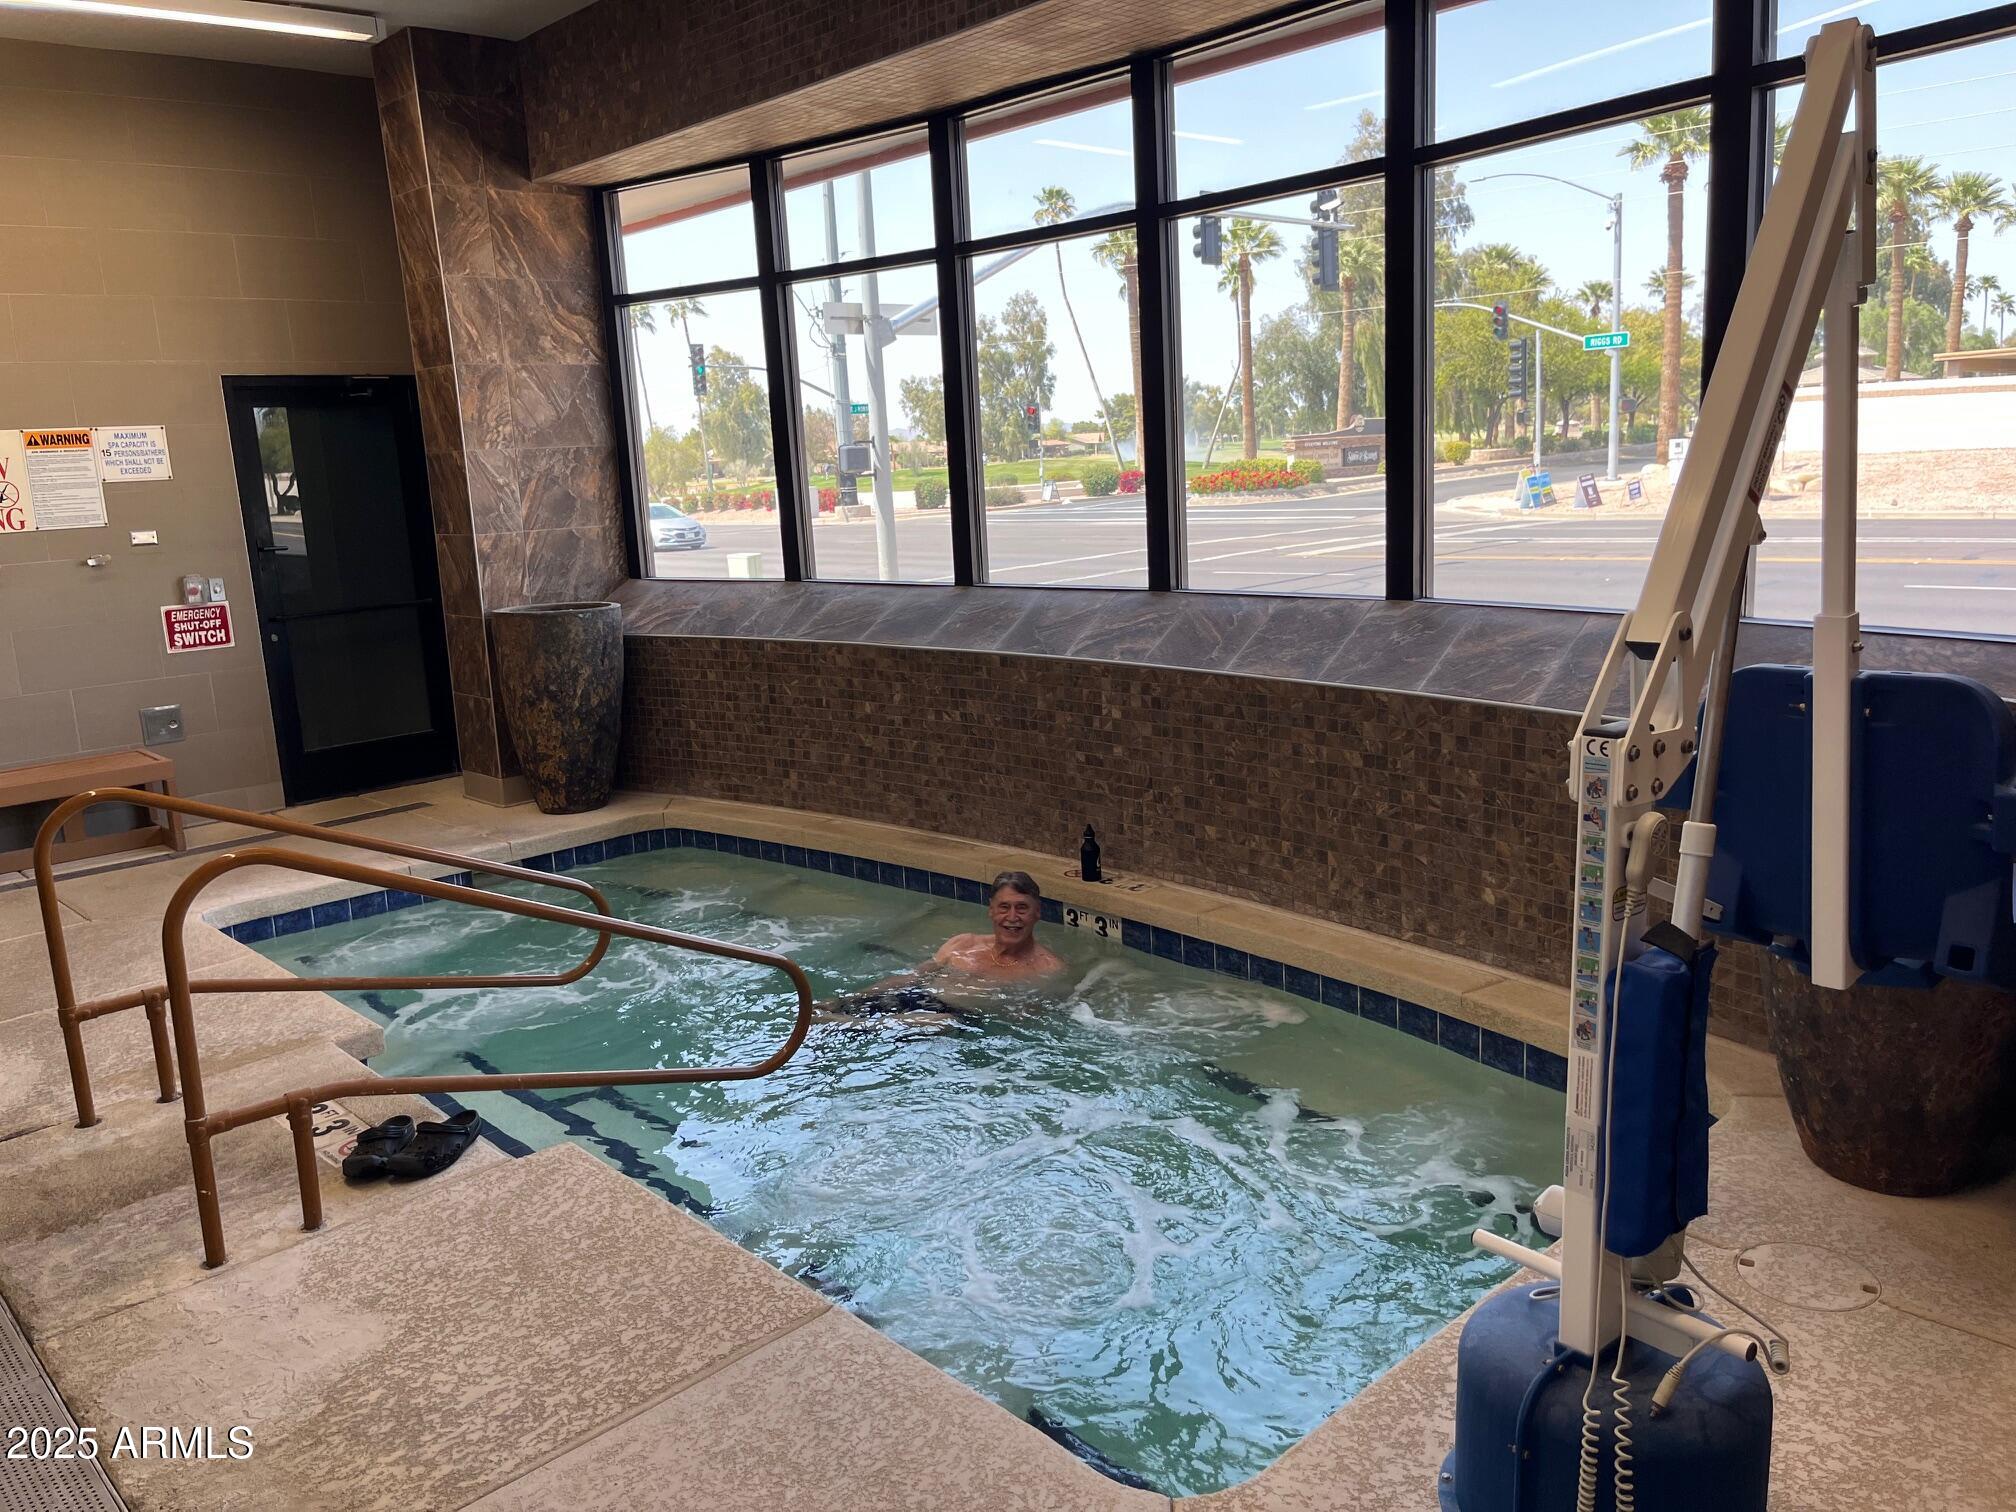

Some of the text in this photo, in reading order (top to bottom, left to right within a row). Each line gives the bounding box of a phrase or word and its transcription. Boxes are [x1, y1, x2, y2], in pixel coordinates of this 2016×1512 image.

[1590, 336, 1622, 346] RIGGS RD
[39, 433, 90, 446] WARNING
[101, 449, 112, 457] 15
[171, 608, 221, 621] EMERGENCY
[174, 619, 221, 631] SHUT-OFF
[174, 629, 226, 646] SWITCH
[1066, 908, 1118, 937] 3 FT 3 IN
